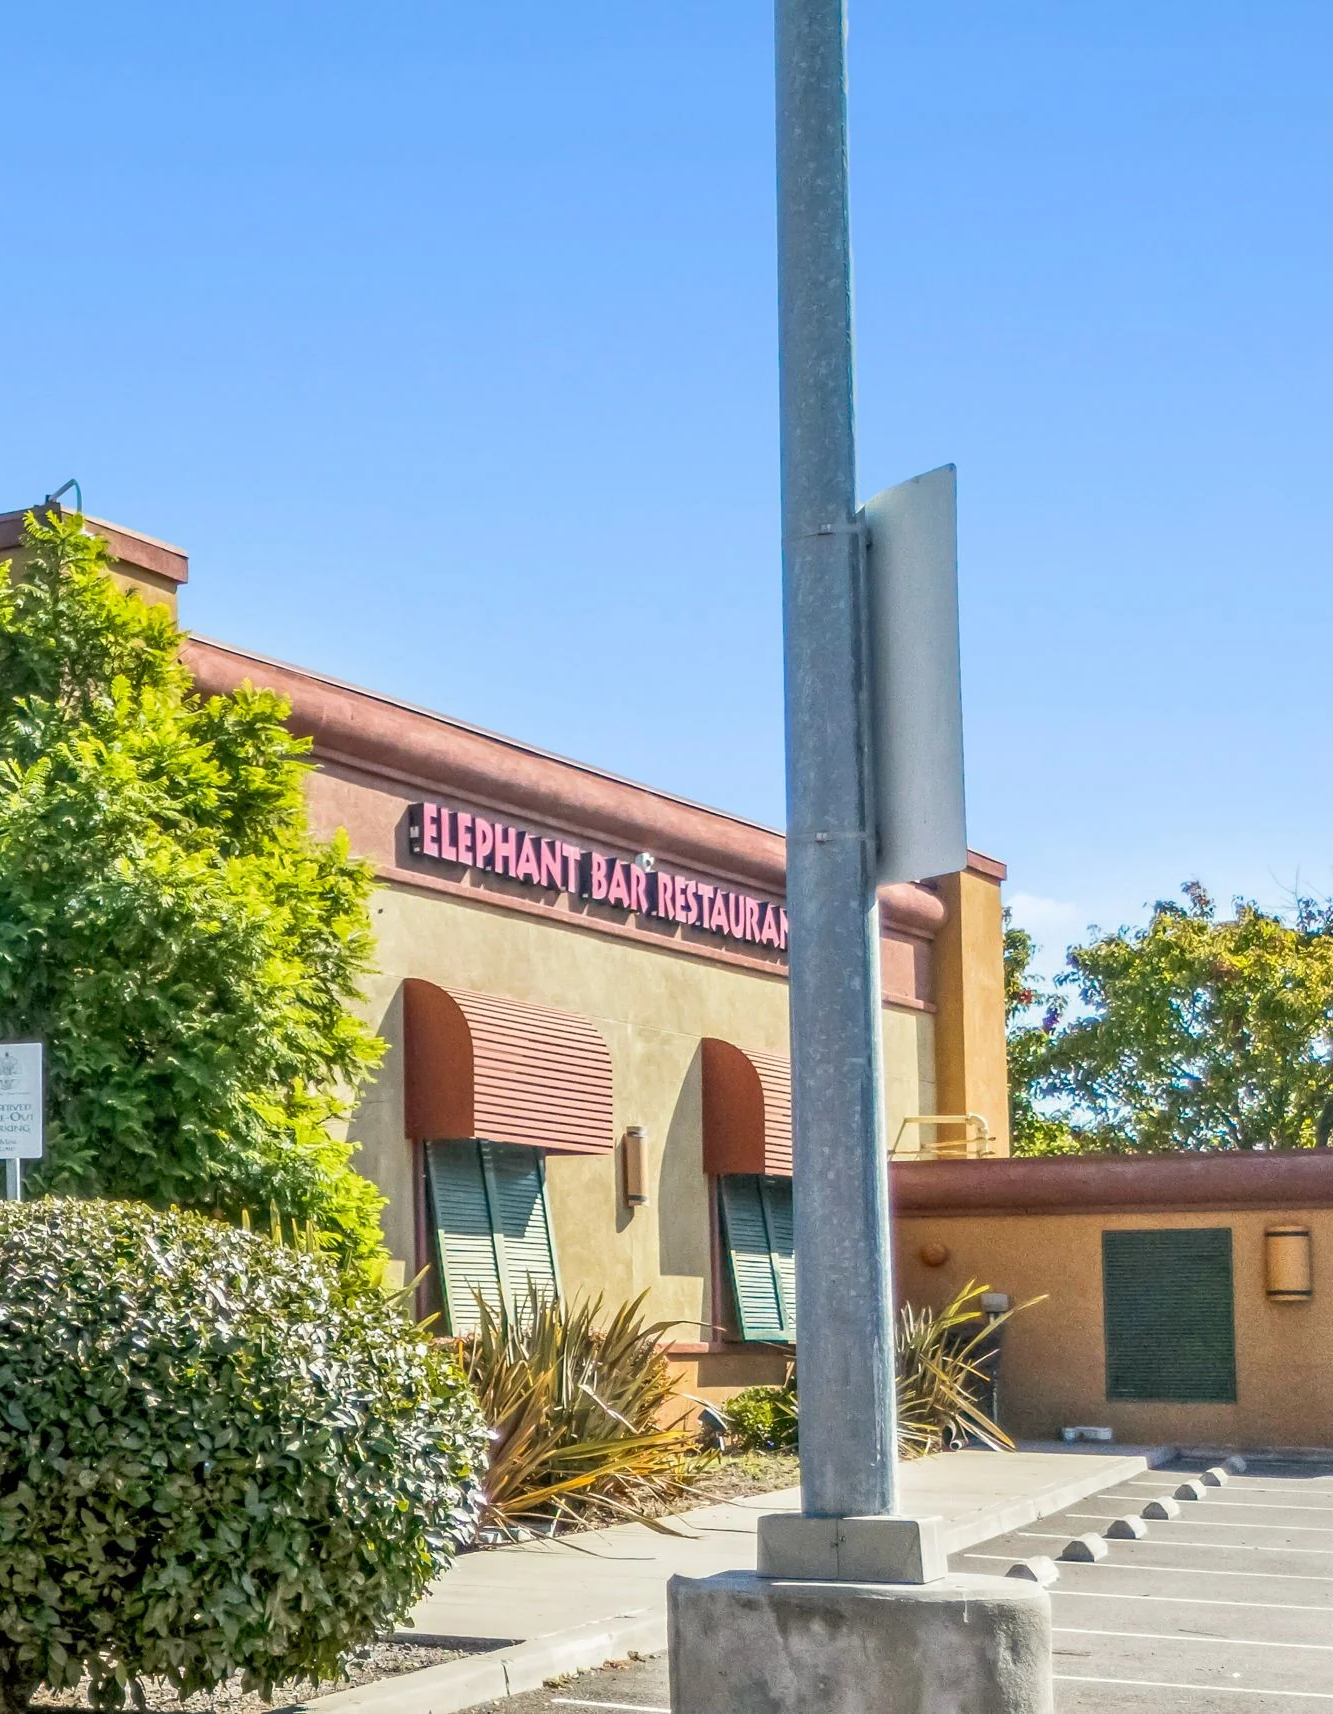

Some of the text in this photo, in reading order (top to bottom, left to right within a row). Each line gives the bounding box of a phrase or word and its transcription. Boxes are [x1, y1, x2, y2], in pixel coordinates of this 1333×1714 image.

[422, 802, 789, 950] ELEPHANT BAR RESTAURAN
